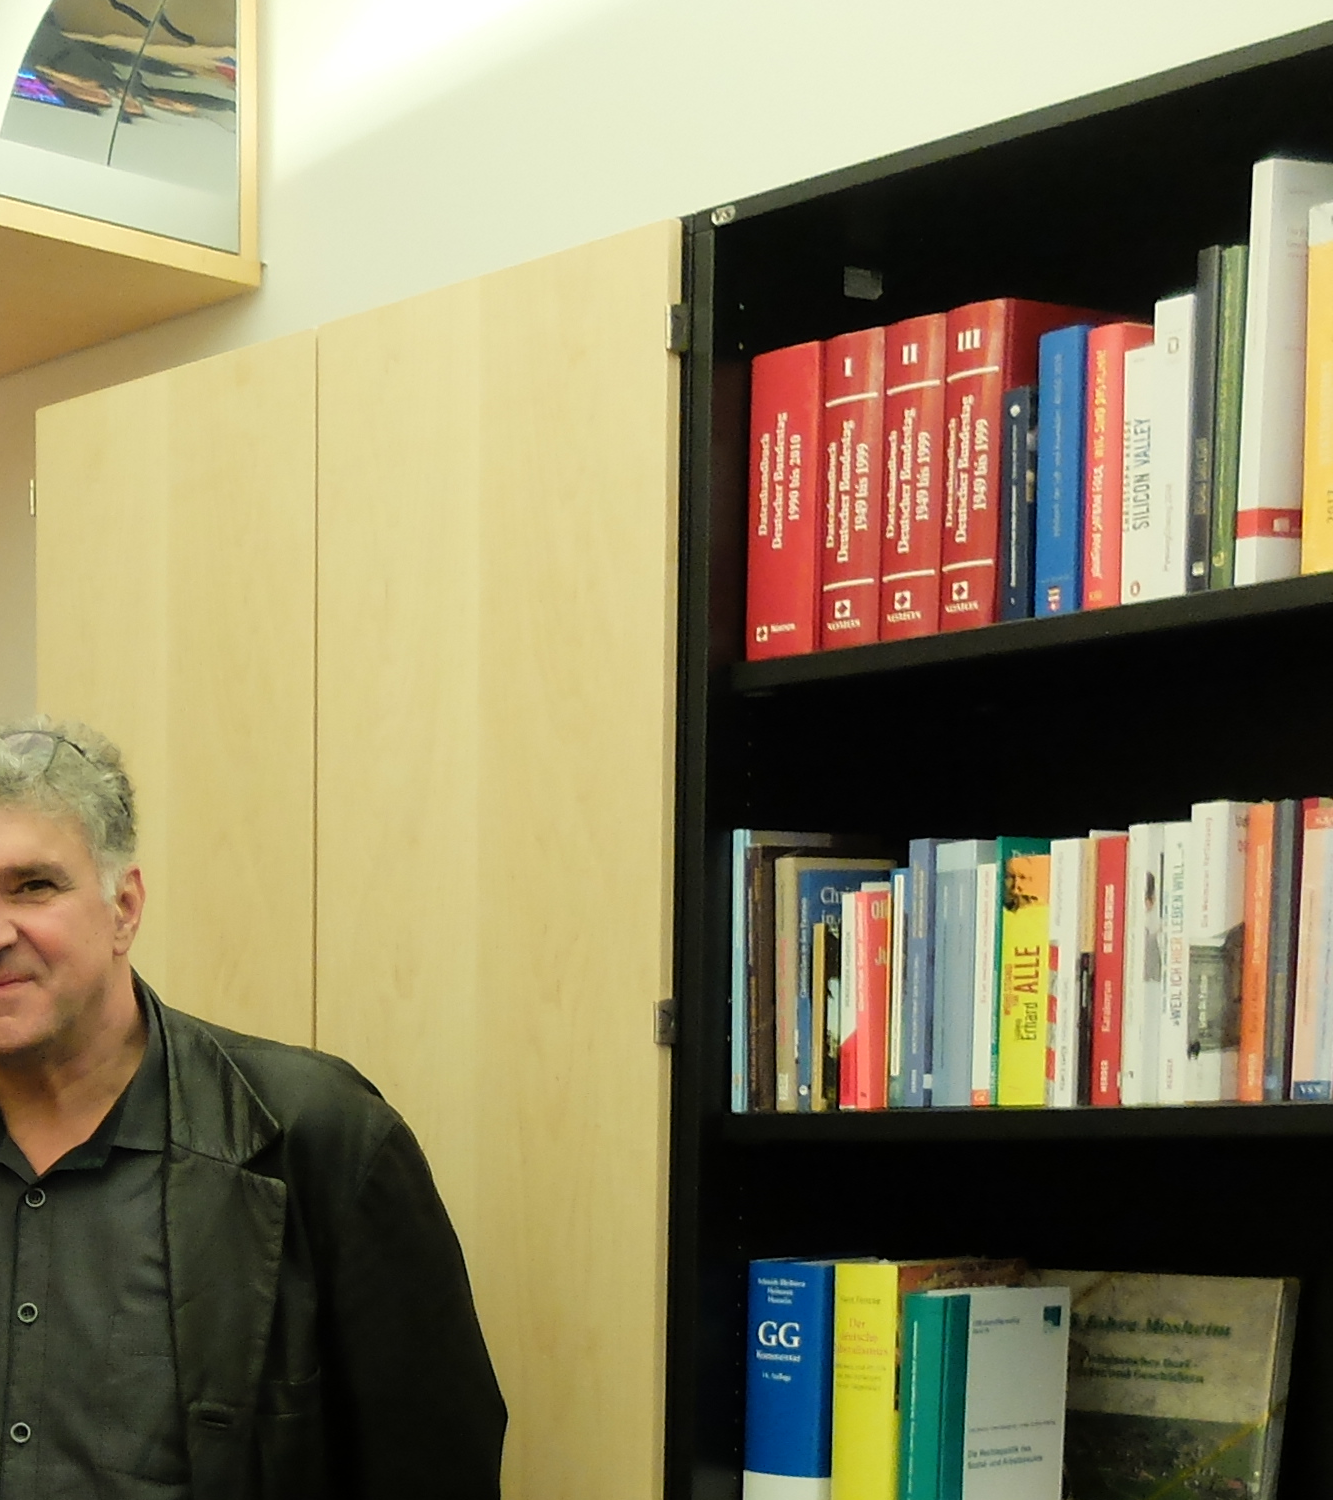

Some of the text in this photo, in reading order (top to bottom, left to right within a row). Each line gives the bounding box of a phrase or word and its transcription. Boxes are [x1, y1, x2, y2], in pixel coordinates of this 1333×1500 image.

[844, 357, 852, 377] I
[901, 343, 918, 365] II
[957, 328, 981, 352] III
[758, 433, 770, 536] Datenhandbuch
[771, 412, 788, 549] Deutscher Bundestag
[789, 434, 802, 520] 1990 bis 2010
[826, 442, 837, 548] Datenhandbuch
[837, 420, 855, 563] Deutscher Bundestag
[855, 443, 869, 531] 1949 bis 1999
[897, 408, 916, 553] Deutscher Bundestag
[915, 431, 930, 520] 1949 bis 1999
[955, 395, 974, 542] Deutscher Bundestag
[973, 419, 988, 510] 1949 bis 1999
[1132, 418, 1151, 531] SILICON VALLEY
[1170, 895, 1183, 934] LEBEN
[1170, 937, 1183, 964] HIER
[1013, 945, 1040, 994] ALLE
[1170, 968, 1182, 987] ICH
[1019, 1002, 1038, 1041] Erhard
[757, 1320, 802, 1348] GG
